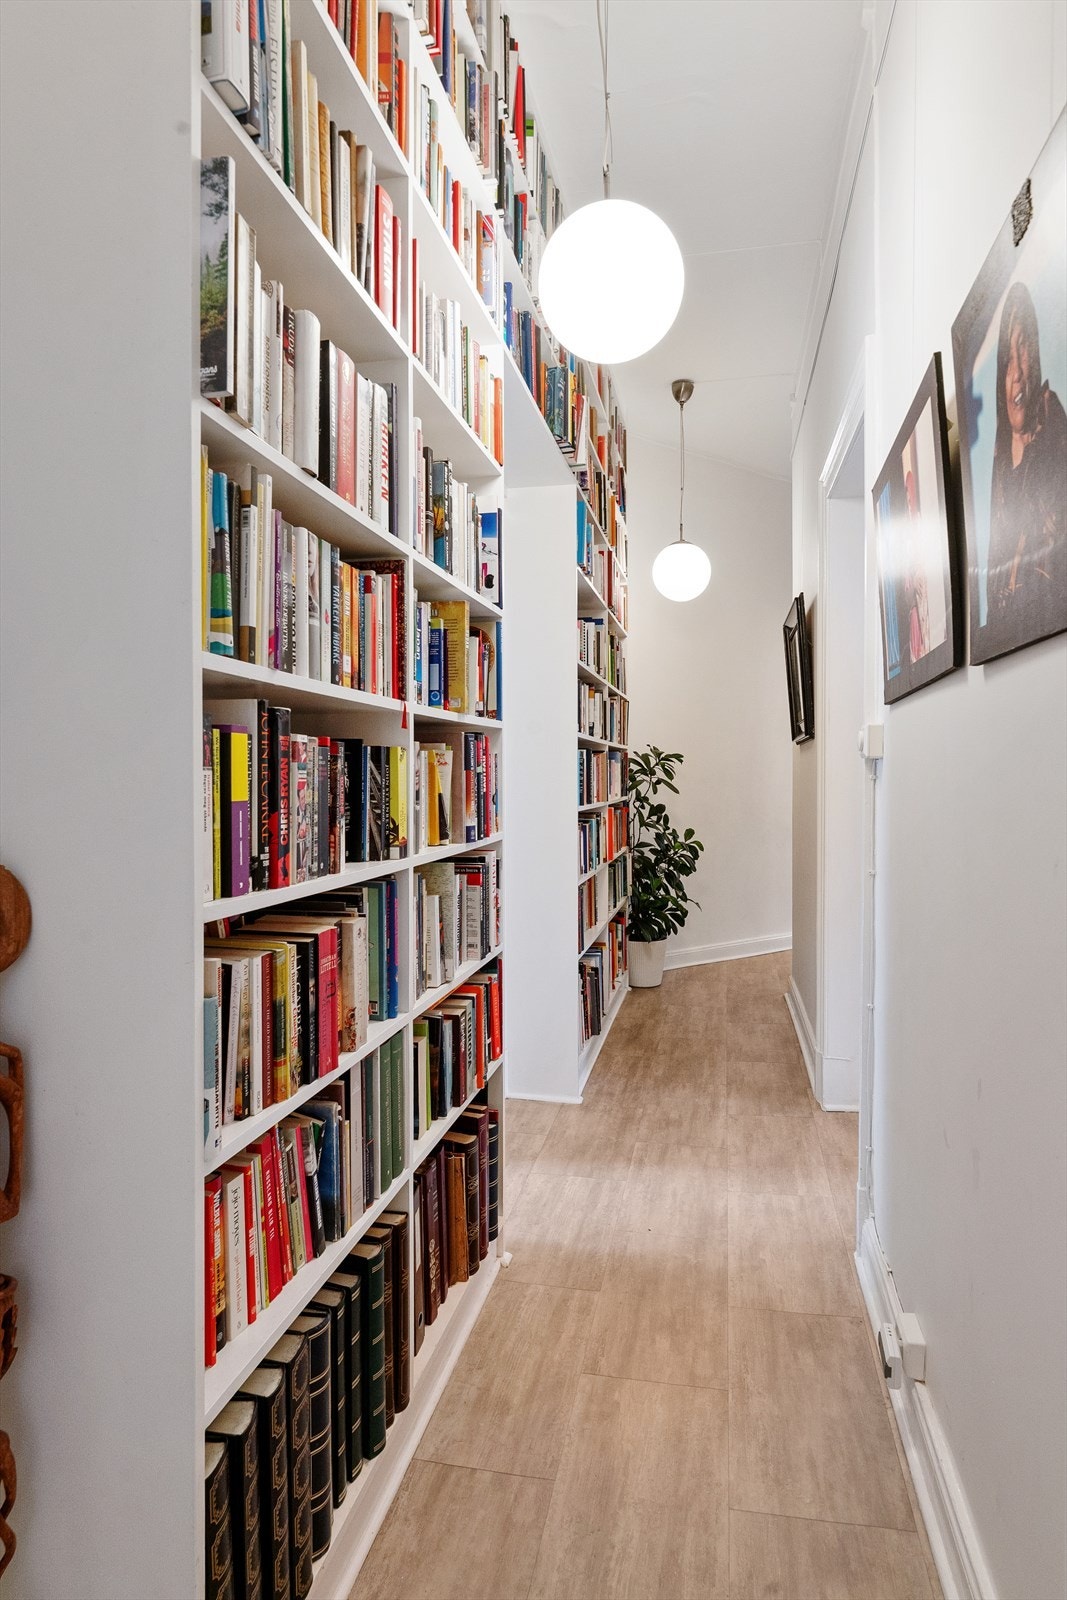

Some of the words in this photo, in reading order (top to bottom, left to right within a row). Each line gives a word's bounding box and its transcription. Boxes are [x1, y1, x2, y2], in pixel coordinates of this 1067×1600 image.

[382, 213, 392, 290] STALIN
[332, 584, 340, 628] VAKKERT
[332, 631, 340, 665] MØRKE
[279, 757, 289, 797] RYAN
[279, 799, 289, 846] CHRIS
[231, 1186, 241, 1210] jojo
[265, 1169, 273, 1207] RUSSLAND
[213, 1189, 222, 1229] WILBUR
[232, 1210, 240, 1247] moyes
